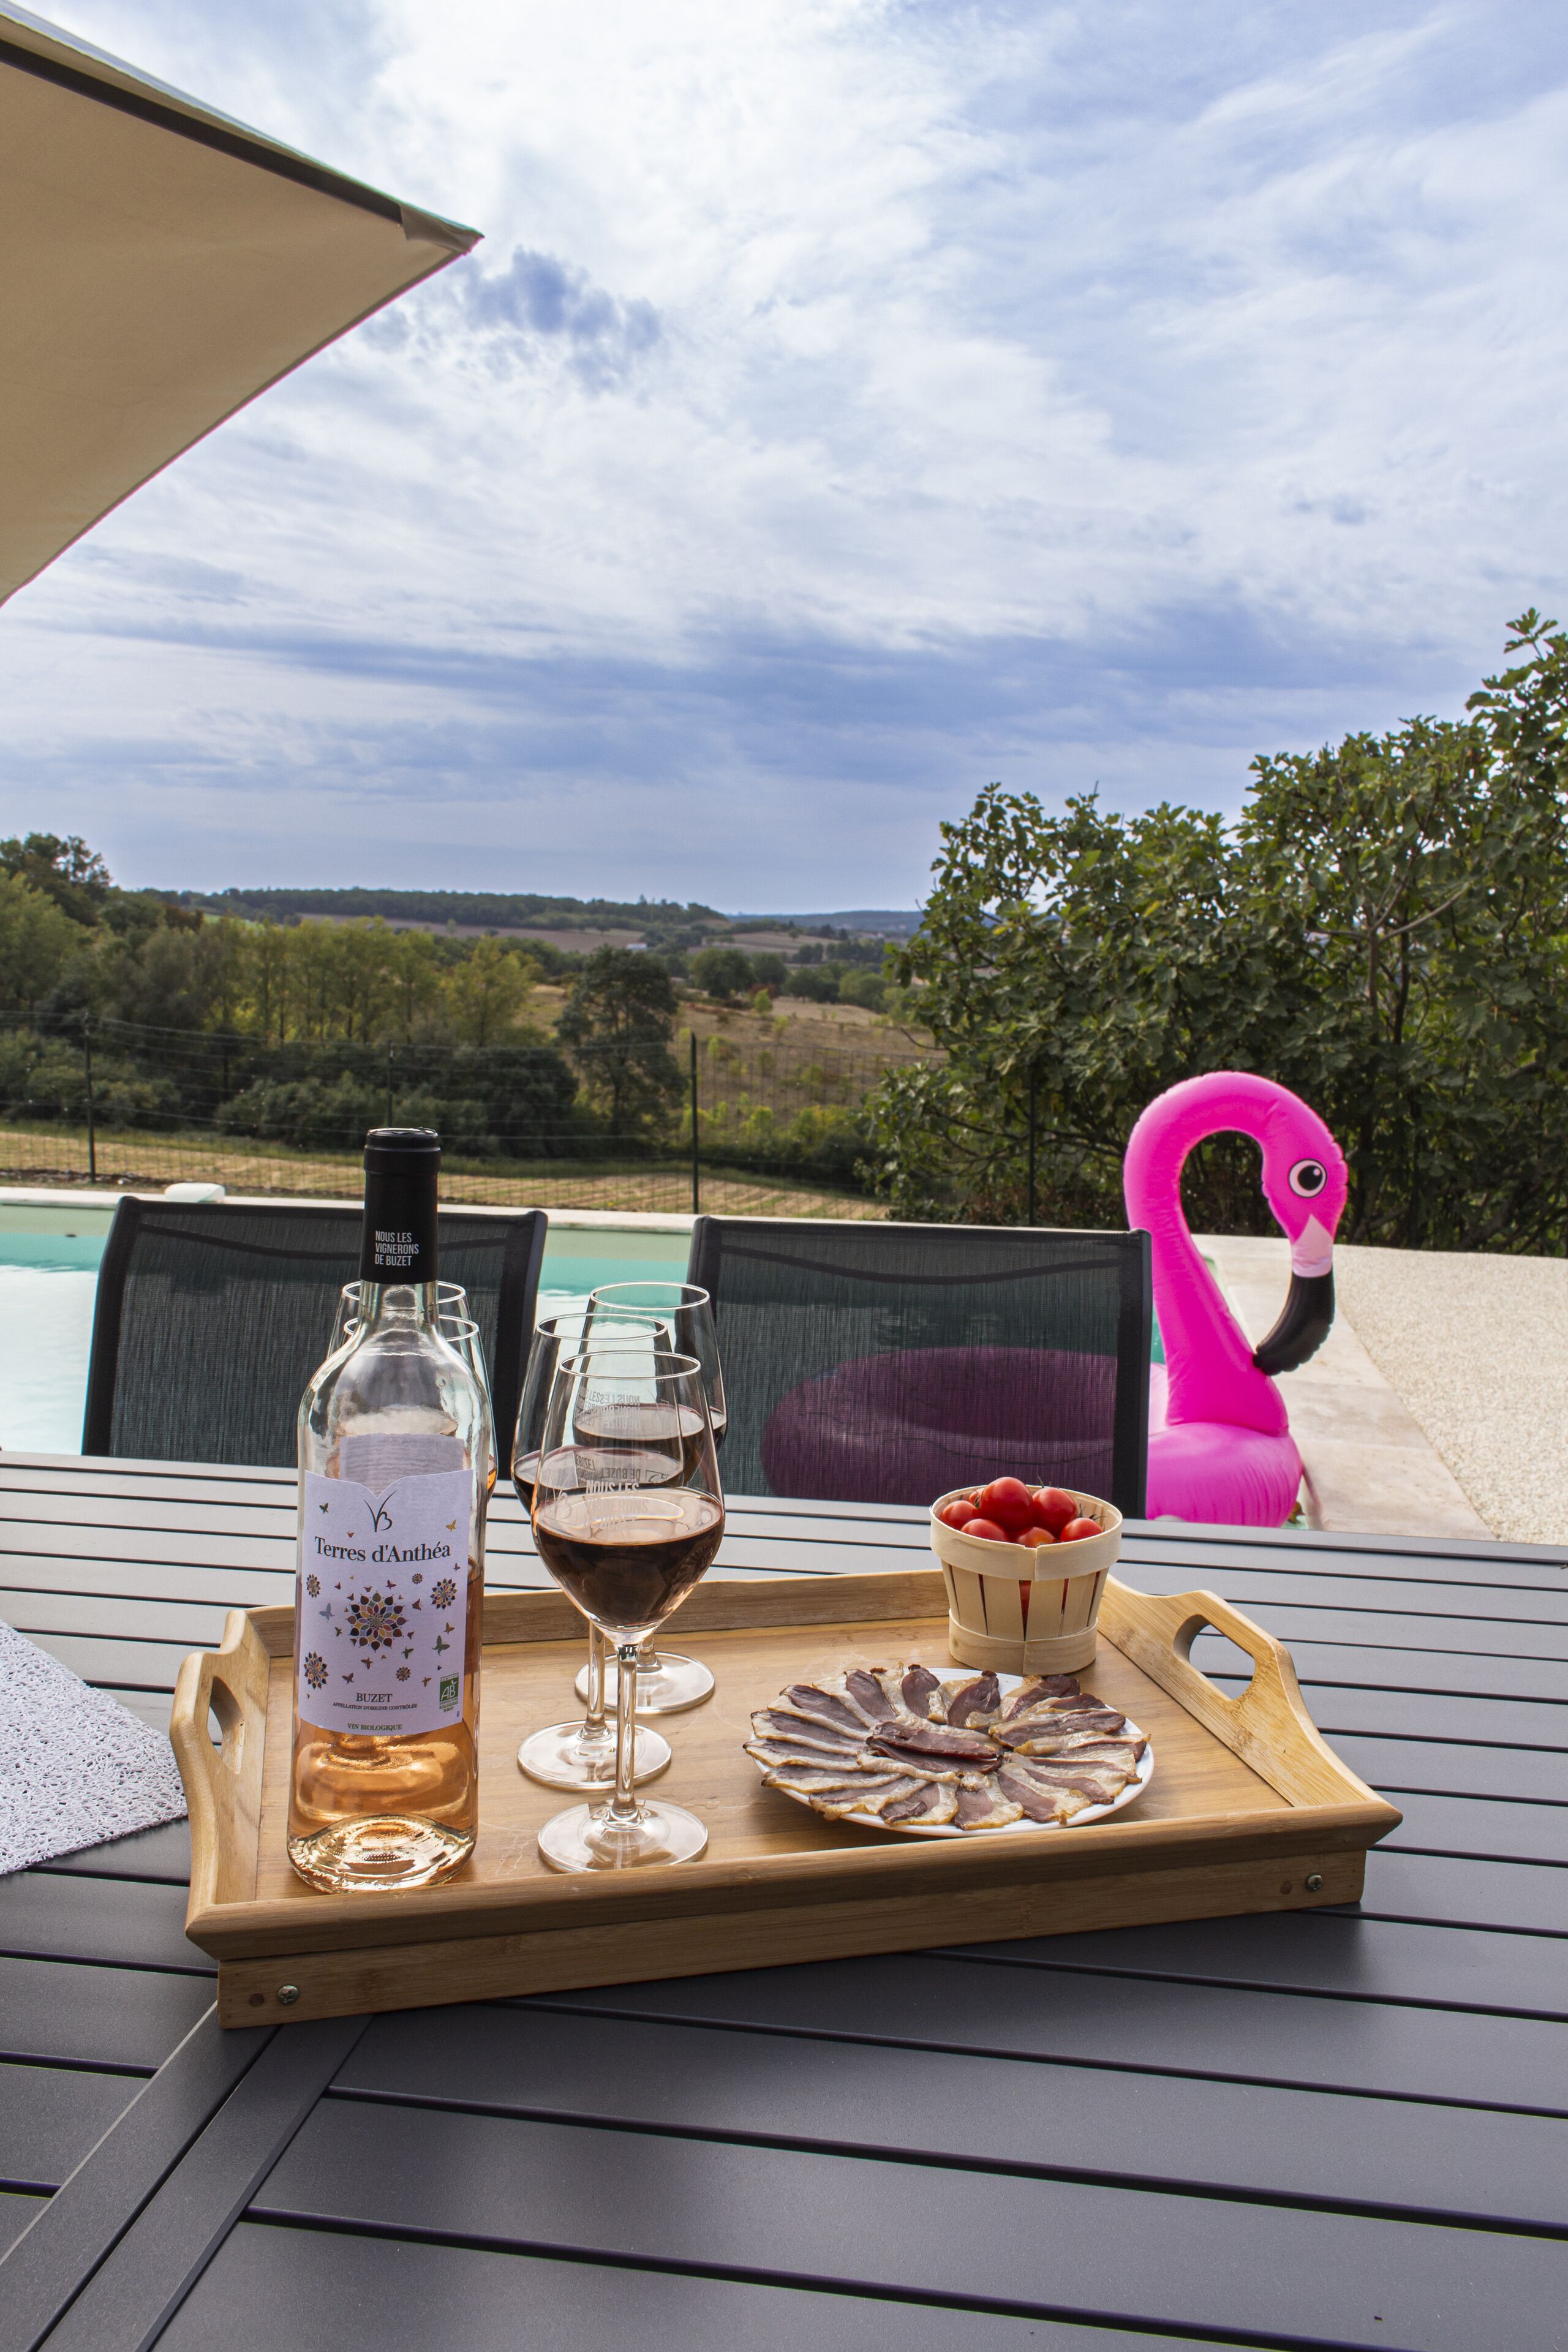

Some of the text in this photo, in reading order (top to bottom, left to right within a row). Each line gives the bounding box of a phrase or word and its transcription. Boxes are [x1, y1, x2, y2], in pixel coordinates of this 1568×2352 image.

[375, 1231, 412, 1243] NOUS LES
[375, 1242, 419, 1254] VIGNERONS
[375, 1254, 412, 1266] DE BUZET
[314, 1536, 451, 1563] Terres d'Anthéa
[356, 1692, 393, 1703] BUZET
[441, 1686, 456, 1701] AB
